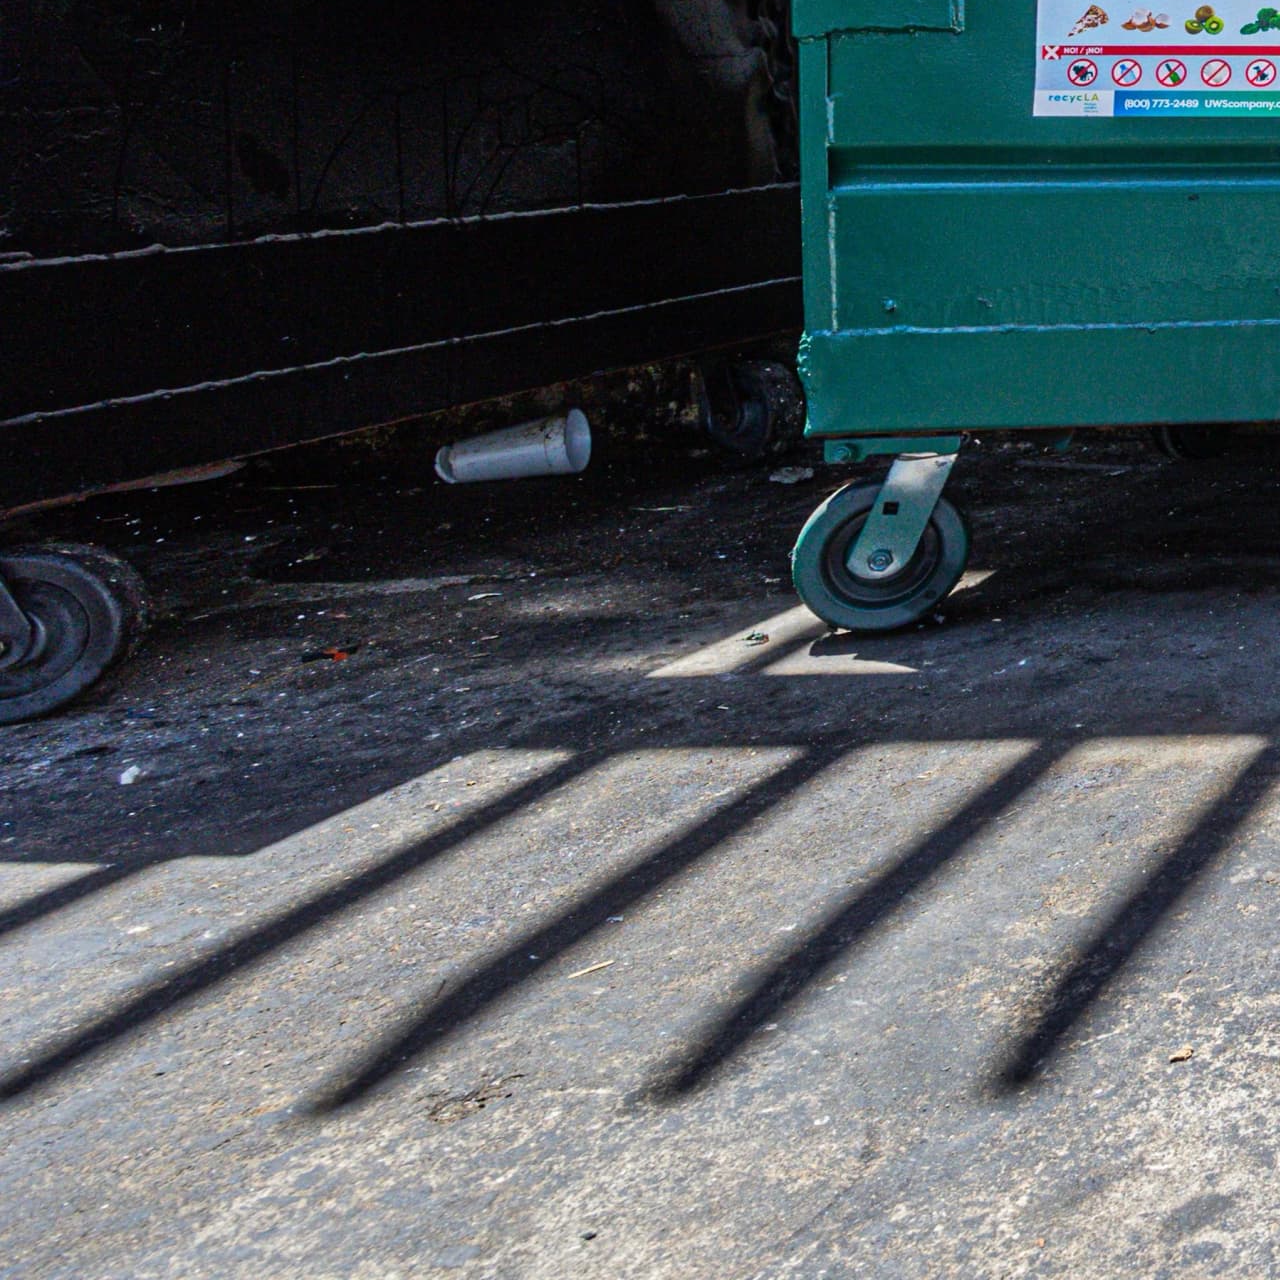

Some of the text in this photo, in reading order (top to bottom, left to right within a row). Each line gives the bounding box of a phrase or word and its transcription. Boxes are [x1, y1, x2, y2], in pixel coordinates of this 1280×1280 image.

[1064, 46, 1079, 54] NO!
[1048, 93, 1099, 103] recycLA
[1124, 99, 1199, 110] (800) 773-2489
